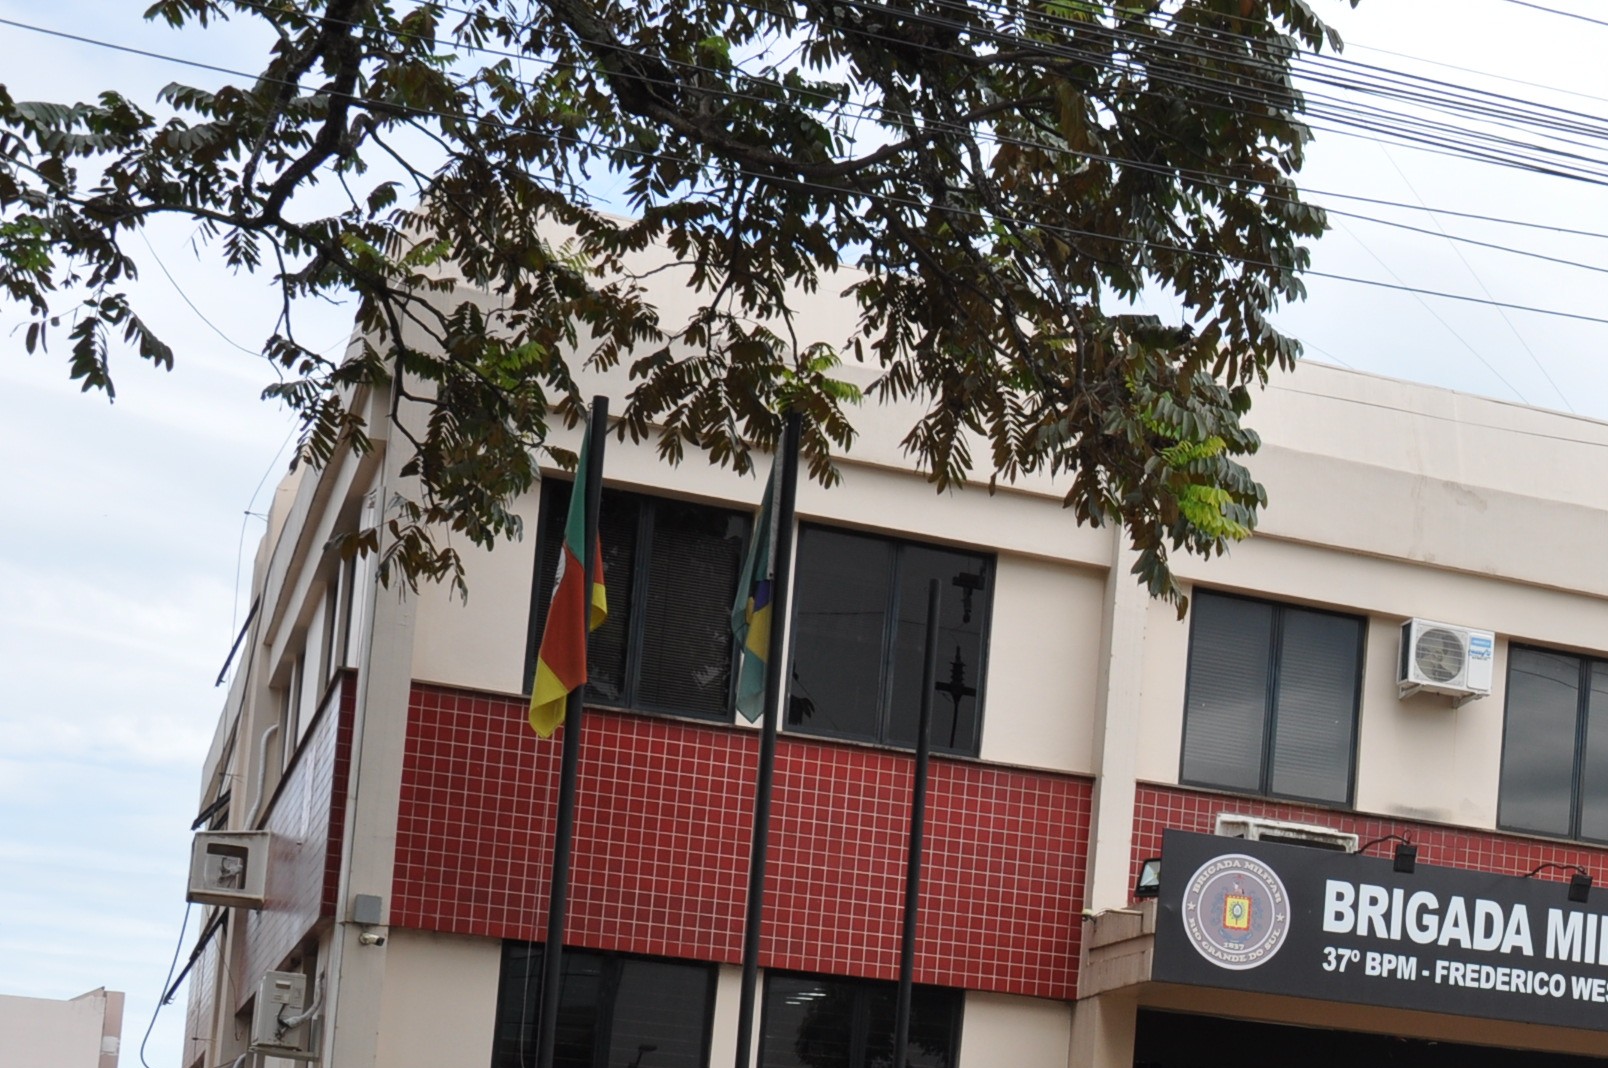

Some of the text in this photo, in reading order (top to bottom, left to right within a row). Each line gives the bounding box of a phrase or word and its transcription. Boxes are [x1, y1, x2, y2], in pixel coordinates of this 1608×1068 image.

[1193, 860, 1282, 903] BRIGADA MILITAR
[1188, 918, 1281, 962] RIO GRANDE DO SUL
[1323, 879, 1534, 956] BRIGADA
[1365, 951, 1417, 980] BPM
[1435, 960, 1566, 998] FREDERICO
